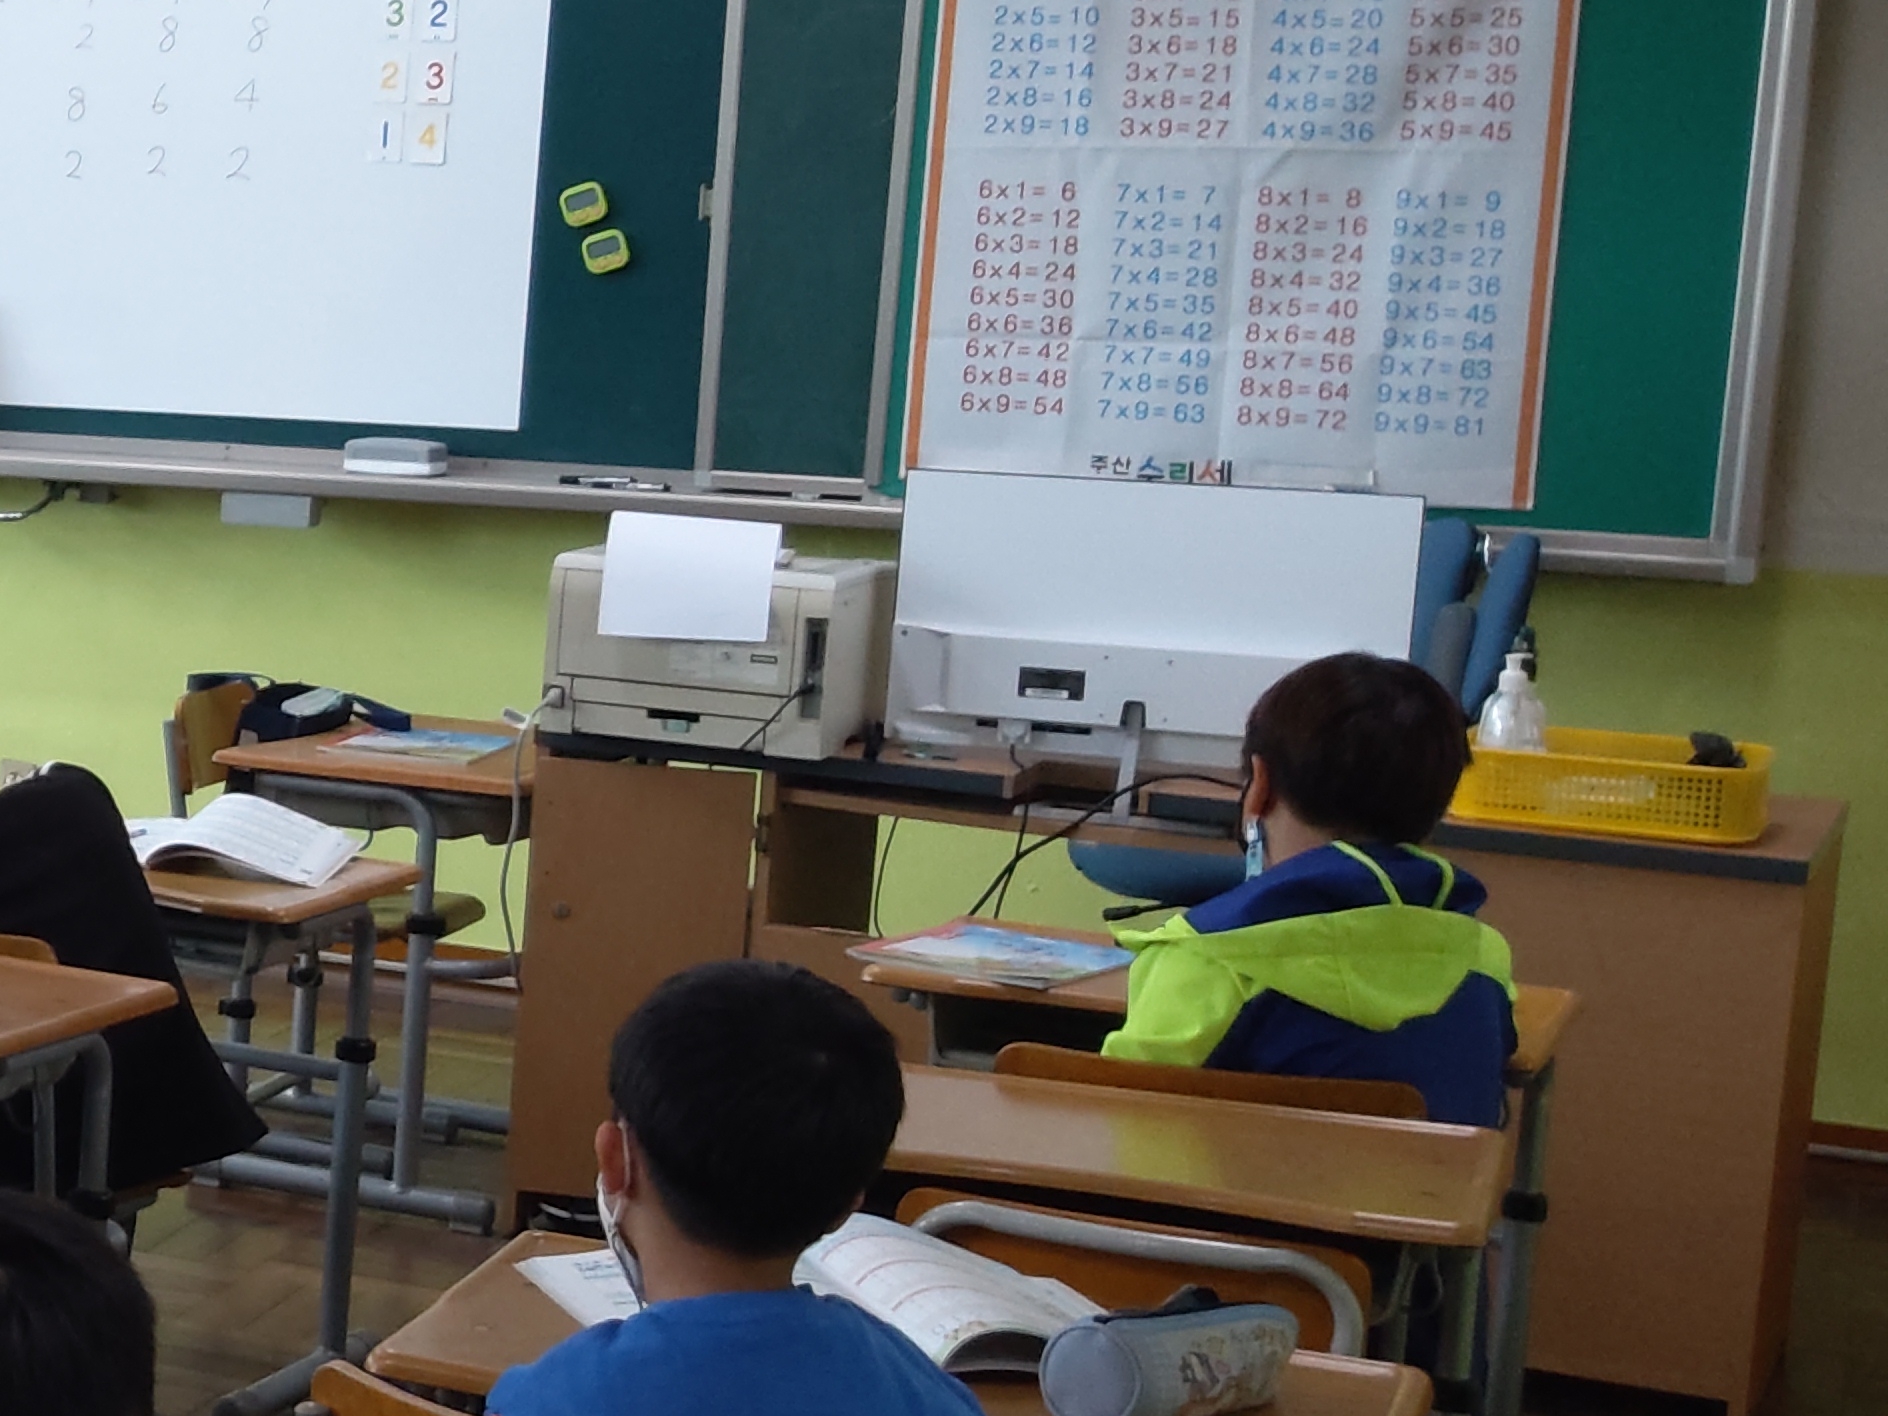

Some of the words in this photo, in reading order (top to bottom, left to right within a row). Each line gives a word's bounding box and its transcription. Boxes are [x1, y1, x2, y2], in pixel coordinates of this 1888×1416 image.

[386, 0, 404, 27] 3
[430, 0, 448, 27] 2
[74, 23, 94, 49] 2
[159, 16, 178, 52] 8
[247, 16, 269, 52] 8
[380, 62, 399, 90] 2
[426, 62, 444, 90] 3
[67, 86, 86, 121] 8
[152, 83, 169, 114] 6
[233, 78, 259, 112] 4
[382, 121, 389, 148] 1
[419, 123, 436, 149] 4
[65, 150, 83, 179] 2
[148, 145, 166, 176] 2
[226, 146, 251, 180] 2
